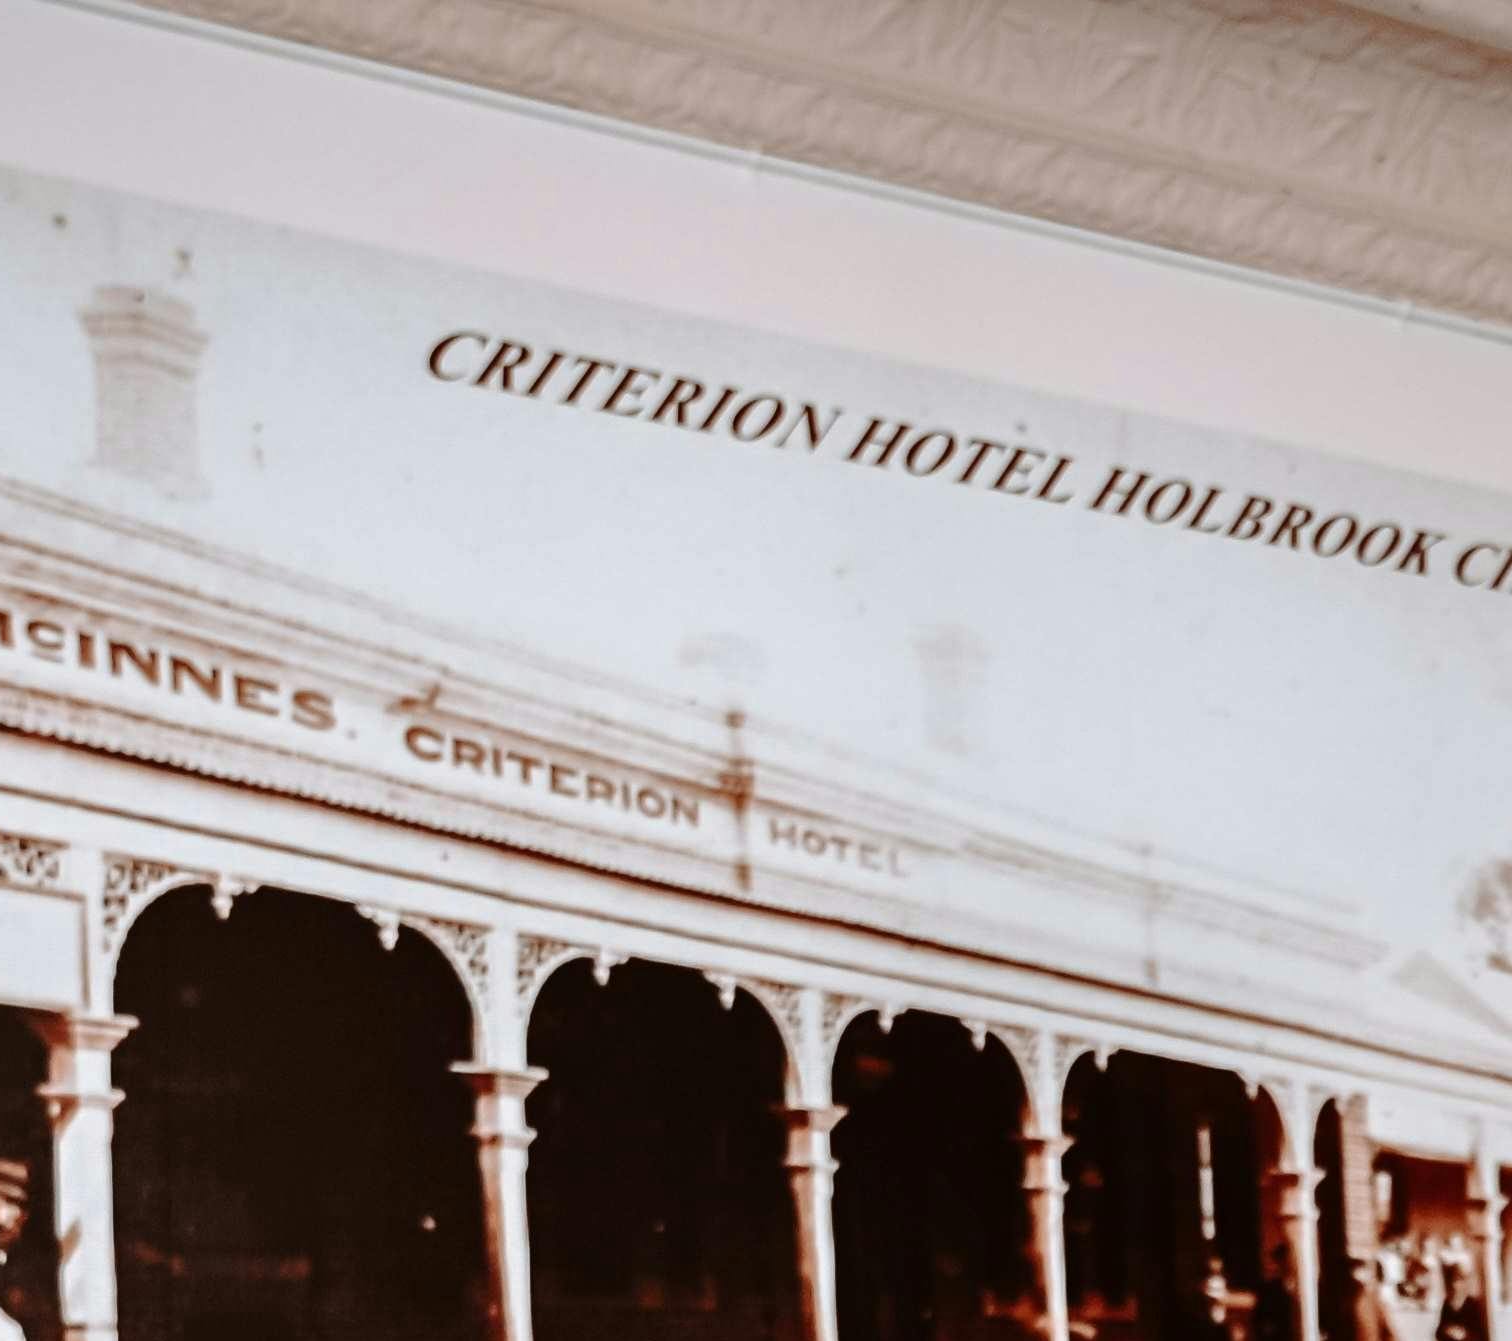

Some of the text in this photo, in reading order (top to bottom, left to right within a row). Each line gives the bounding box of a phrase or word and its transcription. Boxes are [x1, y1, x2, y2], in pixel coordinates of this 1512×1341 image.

[426, 327, 844, 455] CRITERION
[846, 414, 1076, 507] HOTEL
[1089, 466, 1444, 579] HOLBROOK
[403, 724, 912, 880] CRITERION HOTEL
